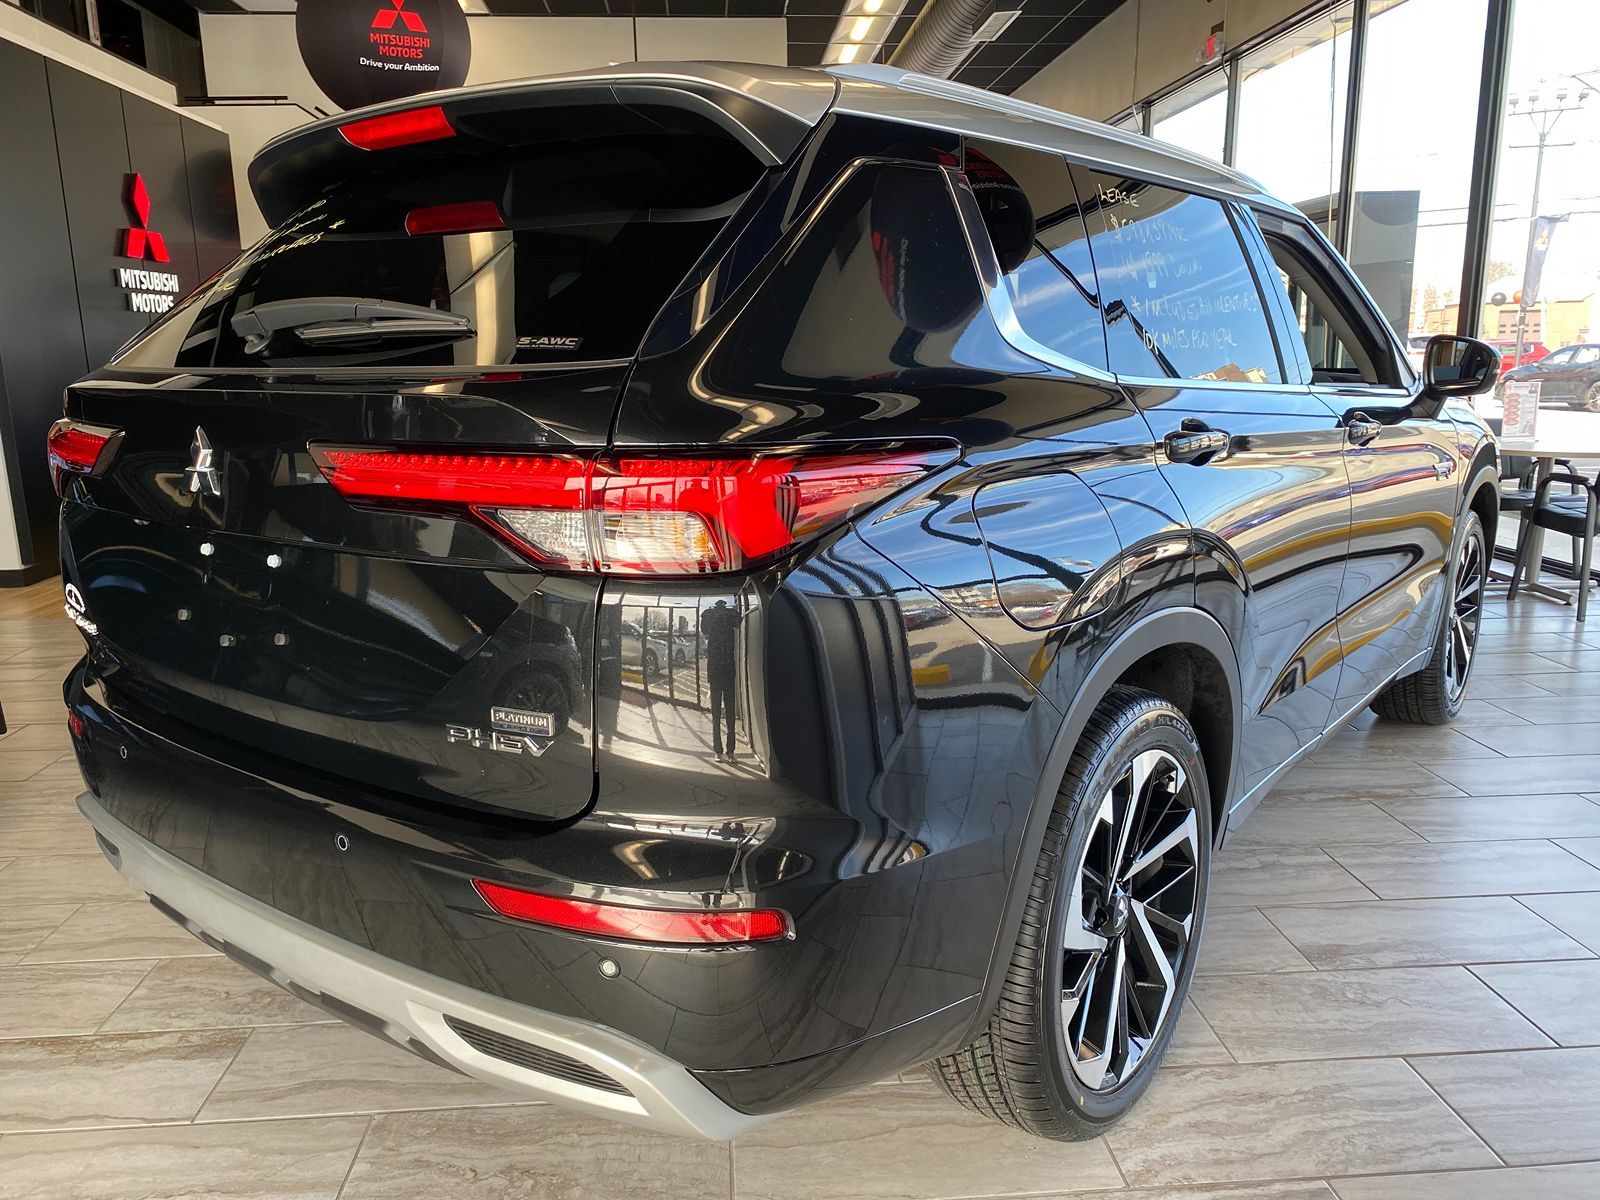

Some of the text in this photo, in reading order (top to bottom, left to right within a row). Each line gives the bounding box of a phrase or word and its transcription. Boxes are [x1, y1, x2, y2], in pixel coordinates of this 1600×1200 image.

[369, 33, 431, 48] MITSUBISHI
[379, 45, 423, 59] MOTORS
[360, 57, 440, 72] Drive your Ambition
[1098, 184, 1140, 207] LEASE
[119, 267, 180, 293] MITSUBISHI
[518, 336, 579, 345] S-AWC
[496, 711, 548, 727] PLATINUM
[446, 724, 555, 757] PHEV
